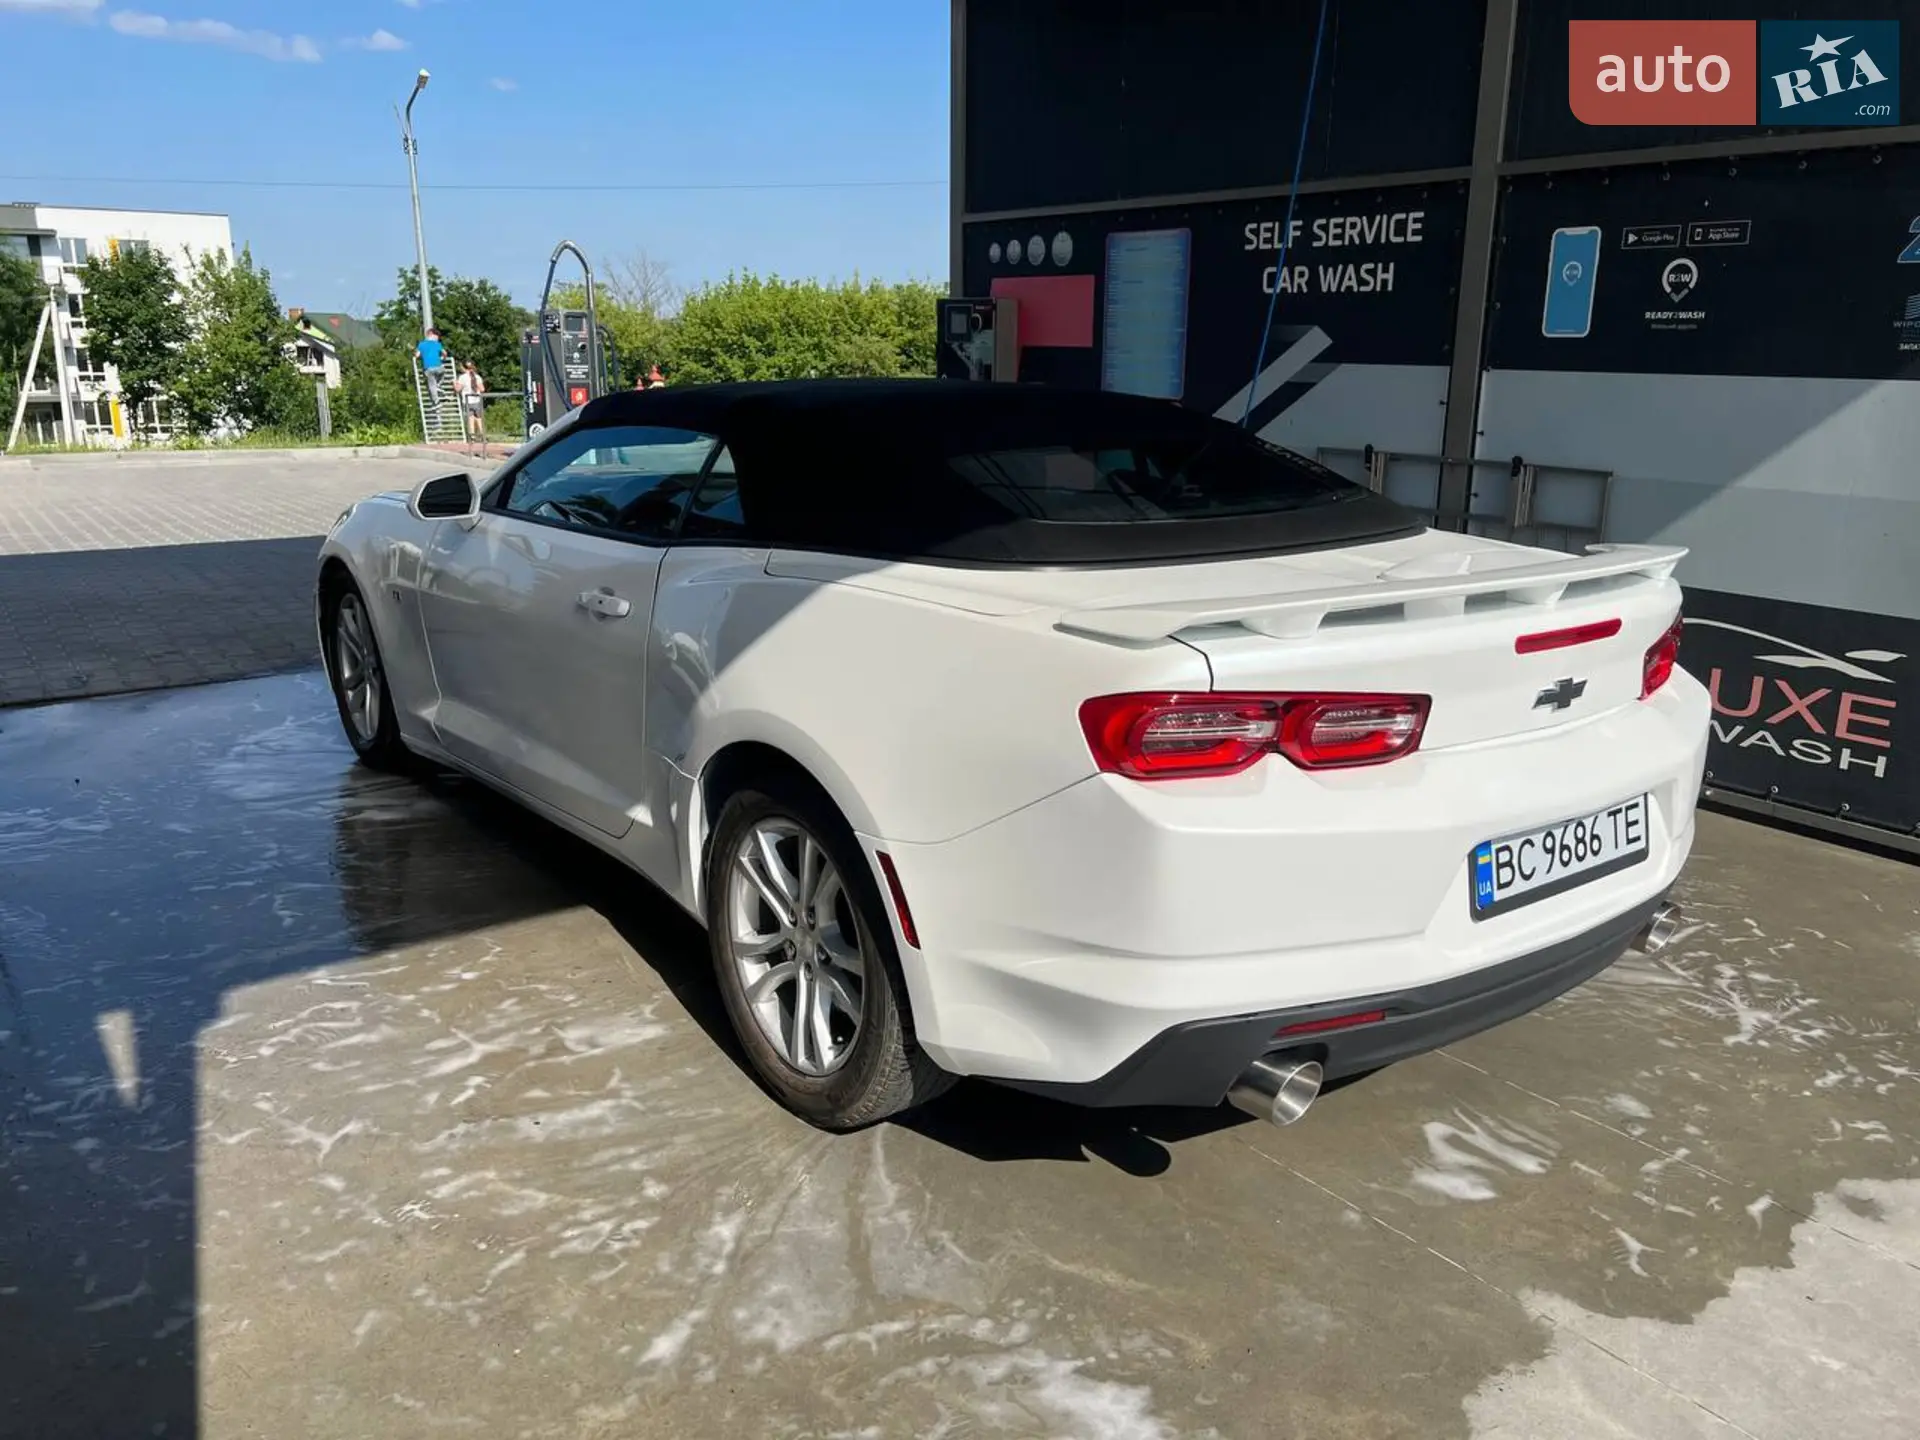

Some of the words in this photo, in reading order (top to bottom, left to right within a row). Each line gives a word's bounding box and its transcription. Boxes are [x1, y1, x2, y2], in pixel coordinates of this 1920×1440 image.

[1244, 220, 1303, 250] SELF
[1311, 211, 1425, 248] SERVICE
[1262, 265, 1309, 294] CAR
[1318, 261, 1395, 293] WASH
[1708, 667, 1897, 749] UXE
[1495, 837, 1537, 891] BC
[1542, 815, 1602, 876] 9686
[1607, 802, 1642, 850] TE
[1478, 880, 1493, 897] UA
